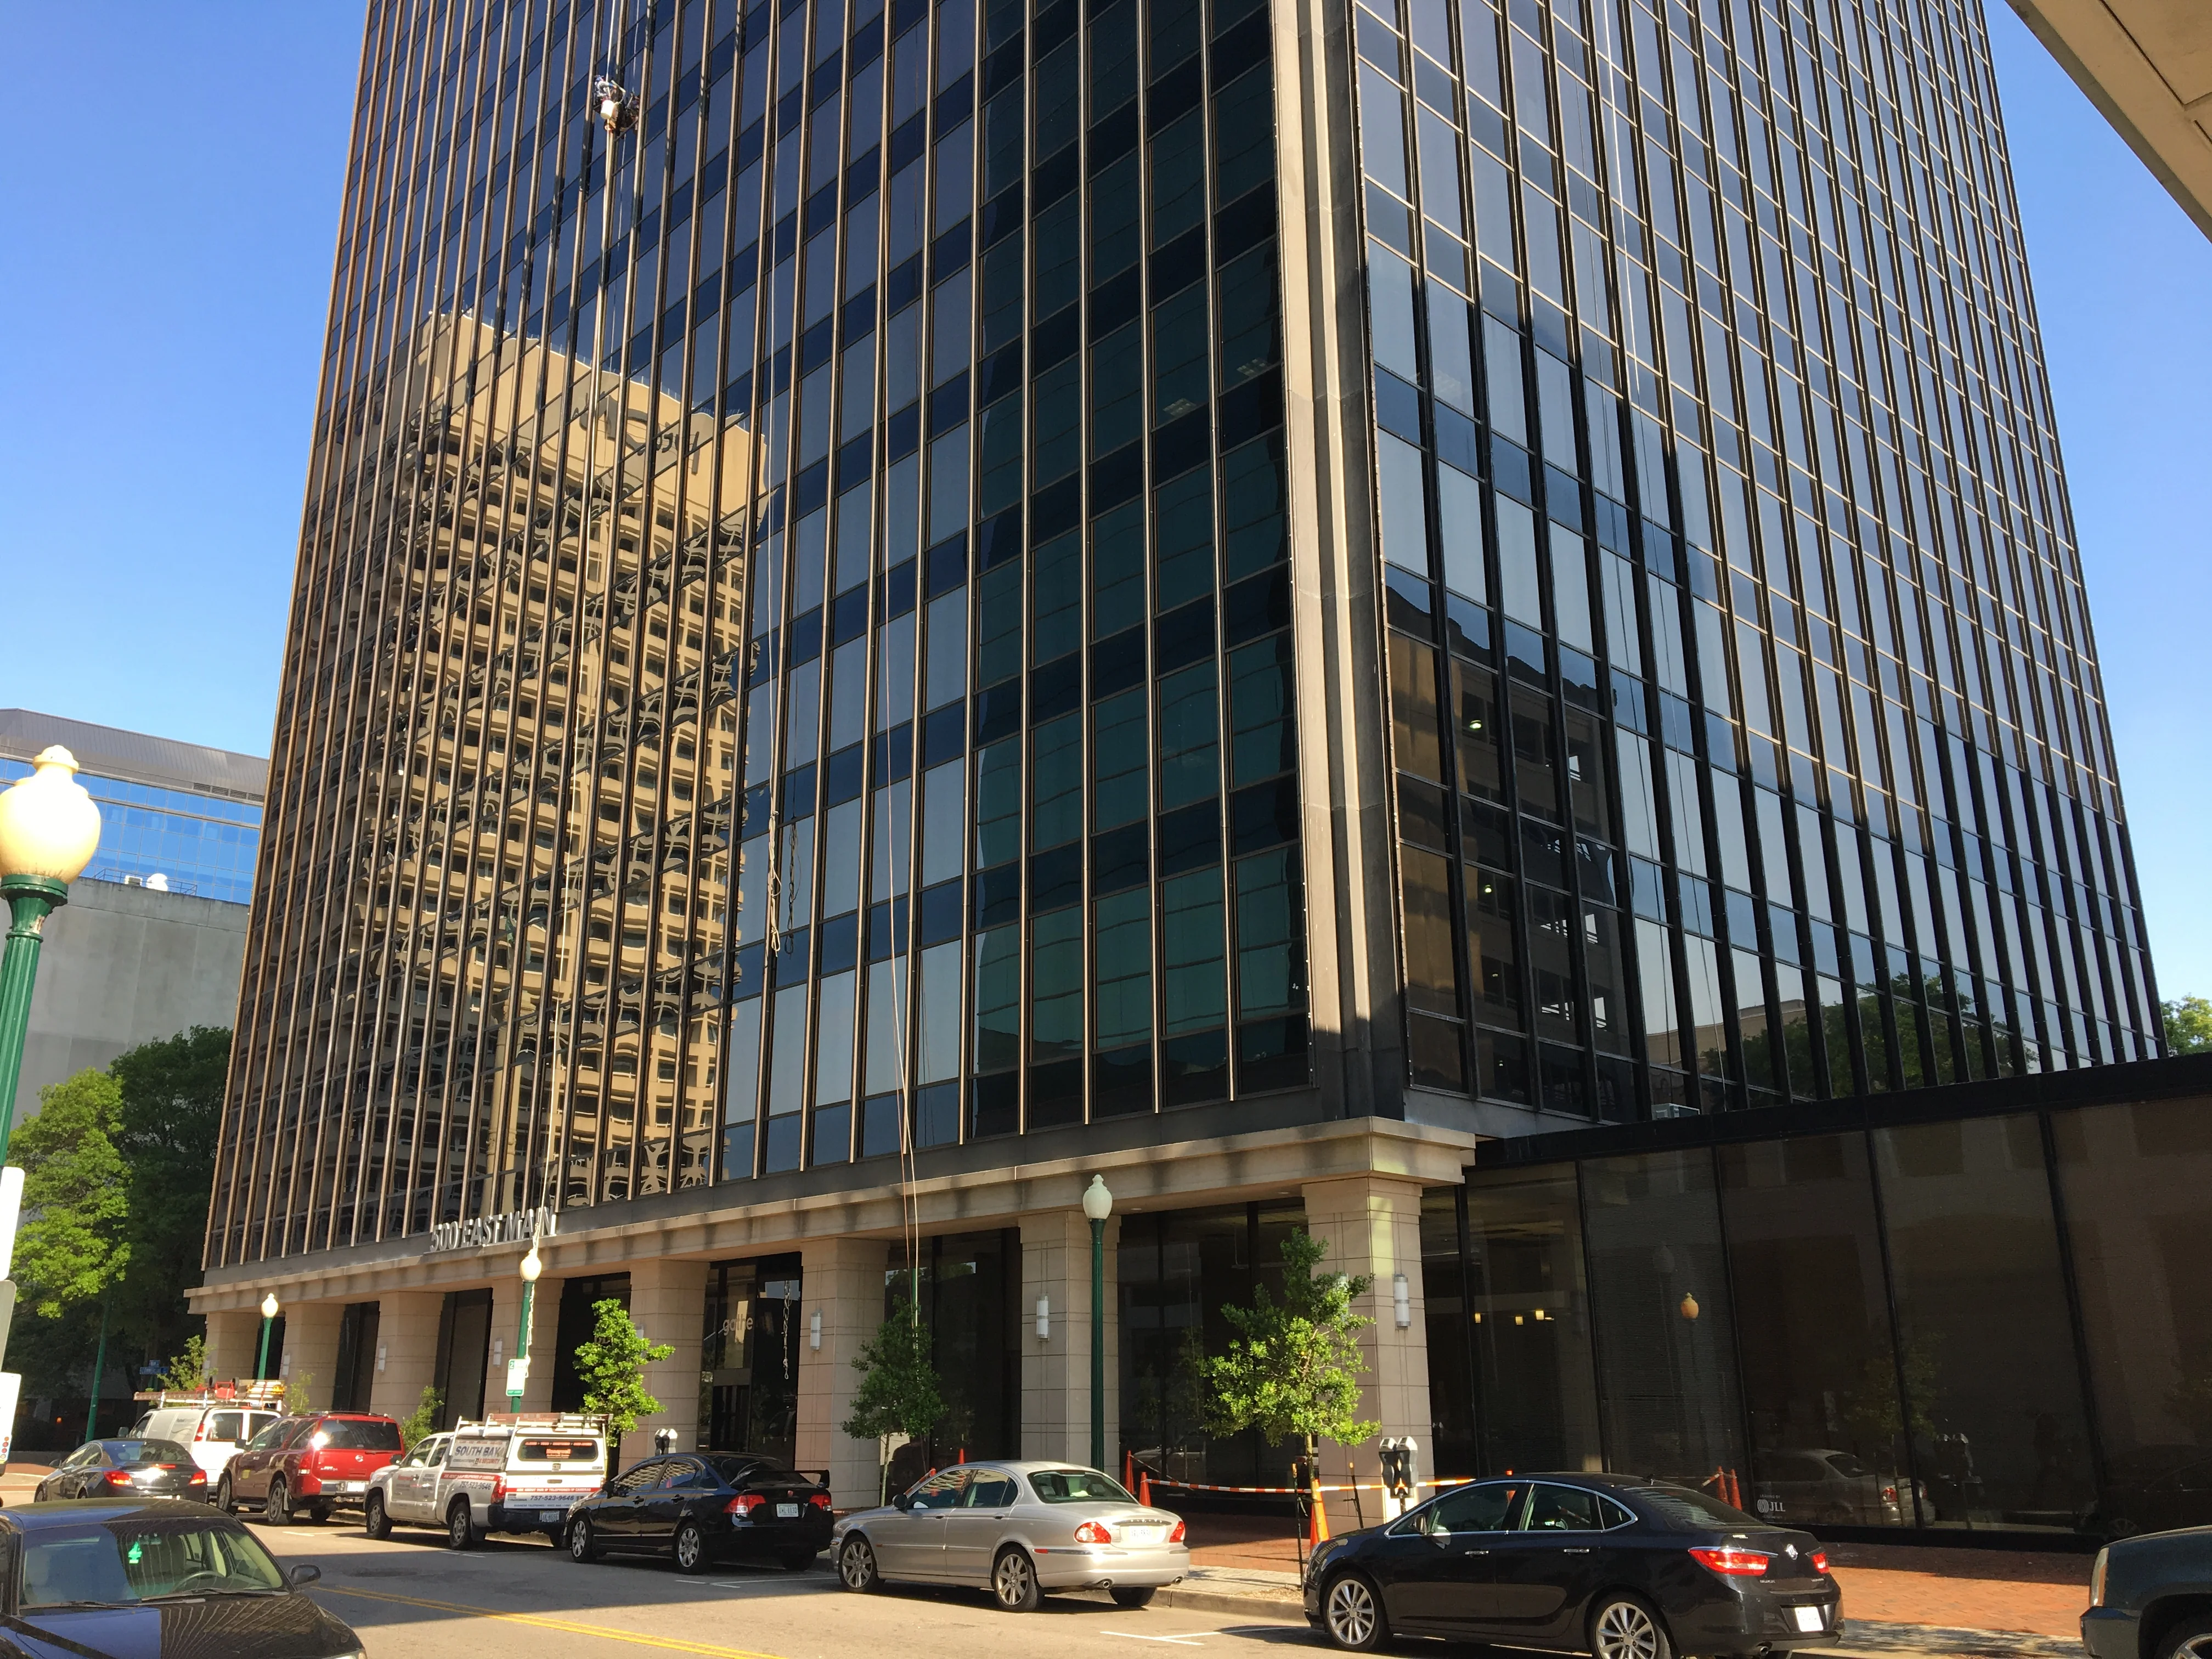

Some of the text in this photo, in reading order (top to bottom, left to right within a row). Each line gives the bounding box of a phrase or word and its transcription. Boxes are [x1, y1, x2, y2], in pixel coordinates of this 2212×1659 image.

[430, 1221, 459, 1252] 500
[461, 1214, 503, 1247] EAST
[455, 1446, 501, 1457] SOUTH BAY
[460, 1481, 492, 1491] 757-523-9646
[1769, 1502, 1786, 1512] JLL
